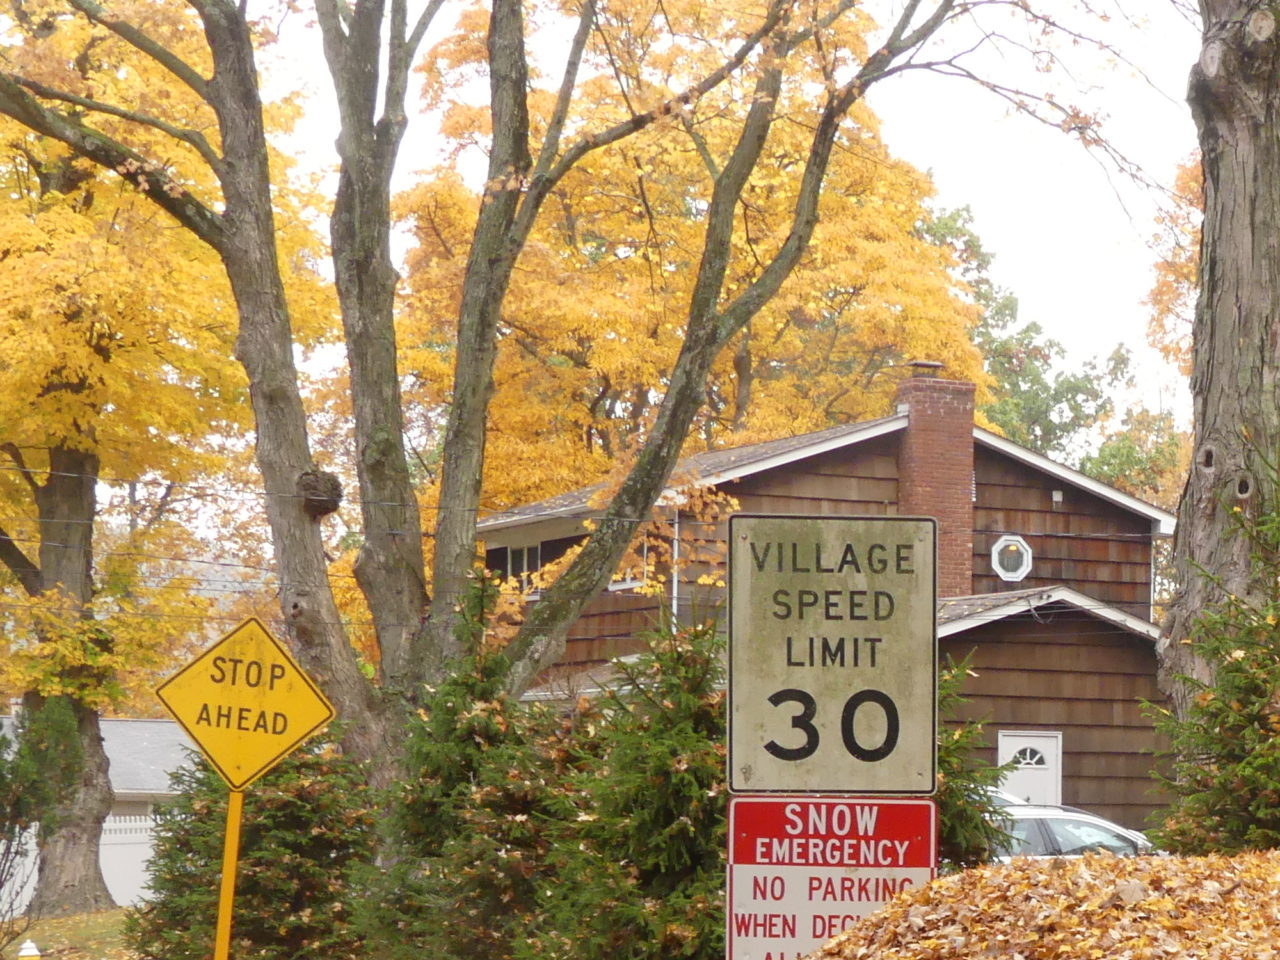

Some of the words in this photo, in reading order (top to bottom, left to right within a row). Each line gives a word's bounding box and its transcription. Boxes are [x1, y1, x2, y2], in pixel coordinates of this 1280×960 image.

[750, 542, 915, 575] VILLAGE
[772, 589, 895, 621] SPEED
[786, 636, 882, 668] LIMIT
[210, 656, 286, 691] STOP
[195, 703, 288, 736] AHEAD
[763, 688, 900, 763] 30
[784, 803, 879, 837] SNOW
[755, 837, 910, 866] EMERGENCY
[753, 875, 785, 902] NO
[734, 913, 796, 939] WHEN
[812, 914, 861, 939] DEC
